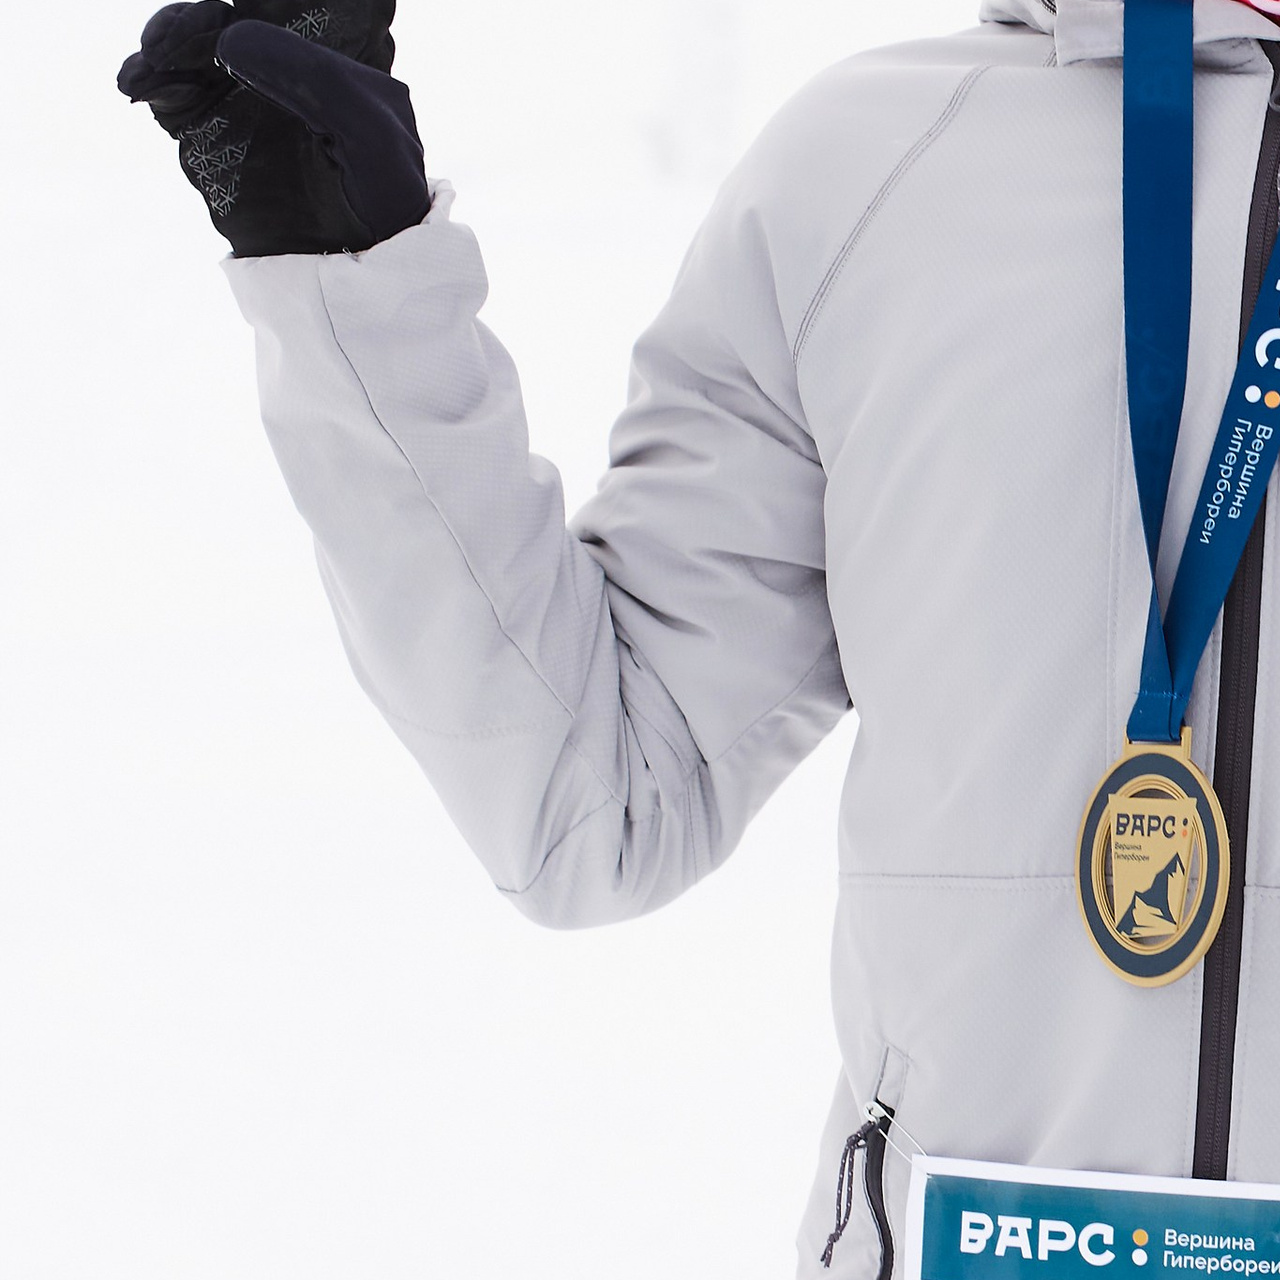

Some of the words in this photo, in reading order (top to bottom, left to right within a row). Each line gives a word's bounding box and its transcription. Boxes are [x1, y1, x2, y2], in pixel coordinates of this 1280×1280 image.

[1199, 418, 1253, 545] Гипербореи
[1227, 423, 1274, 520] Вершина
[1163, 1228, 1255, 1252] Вершина
